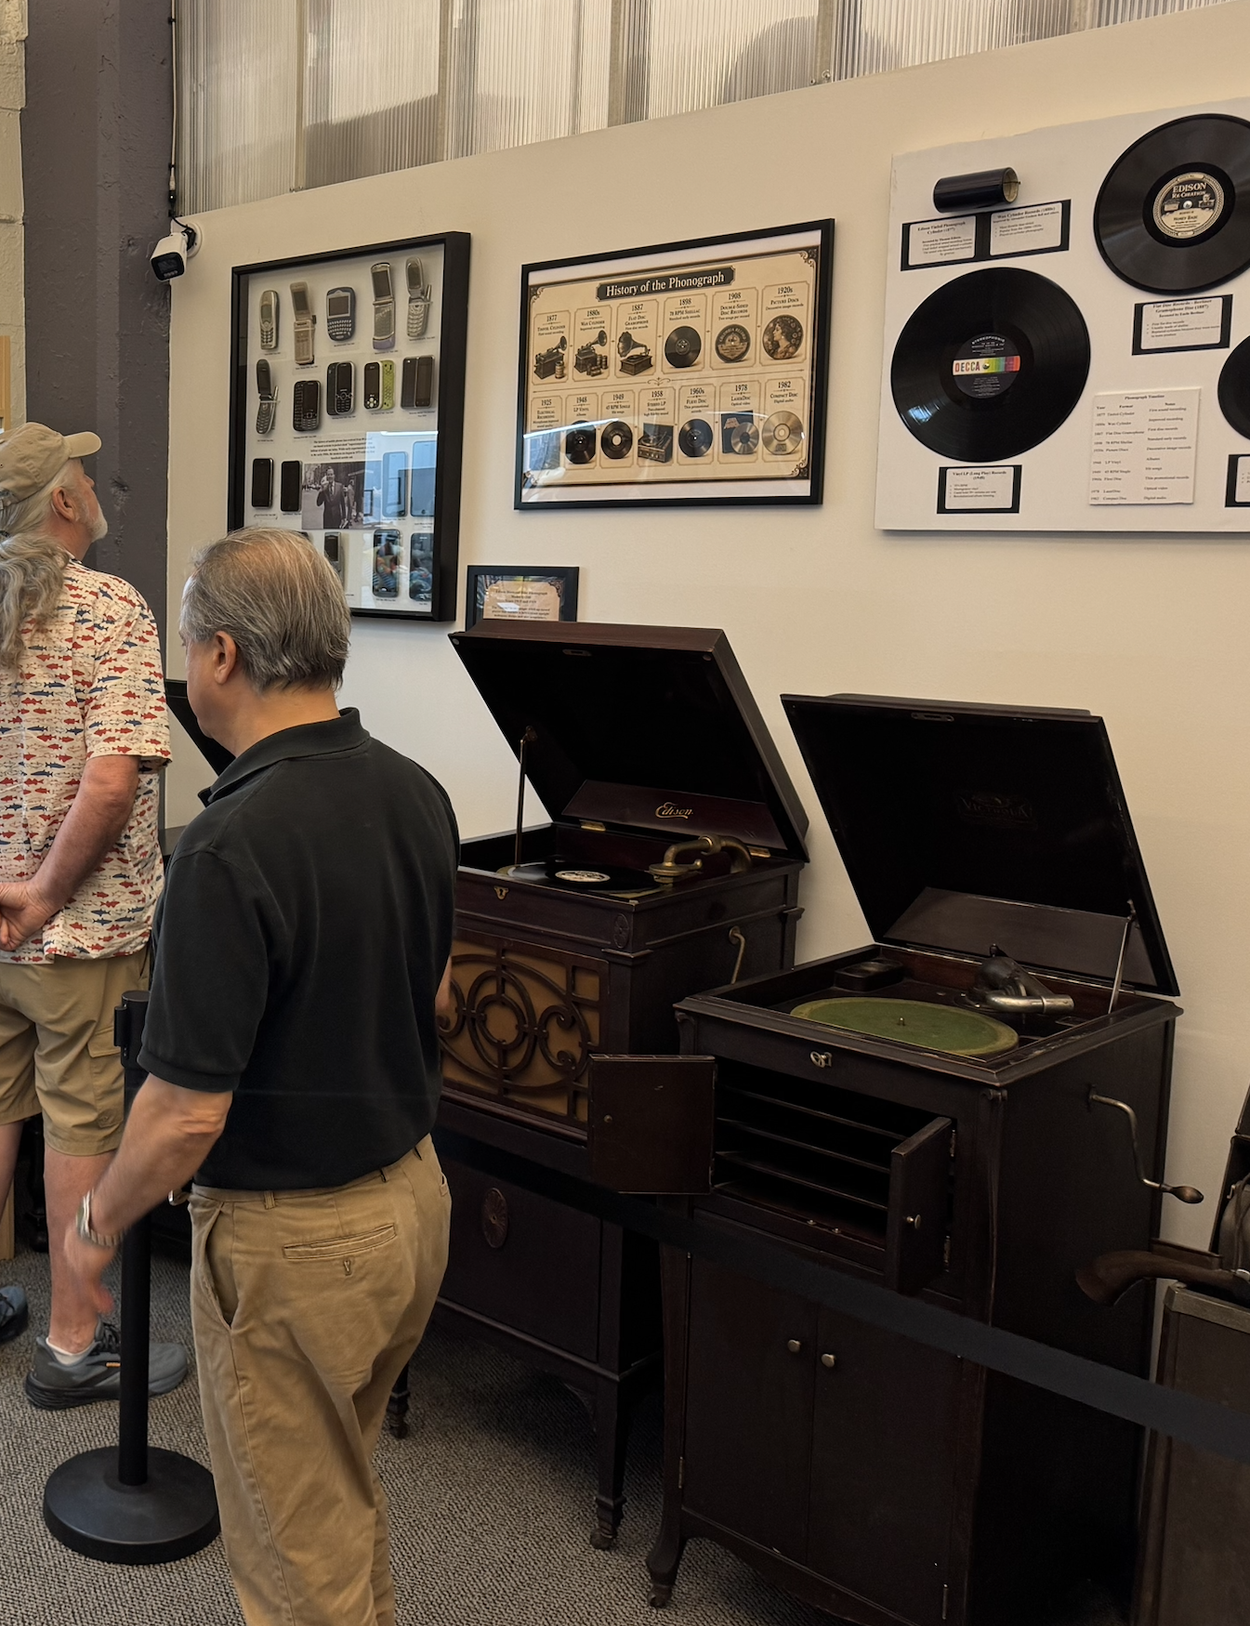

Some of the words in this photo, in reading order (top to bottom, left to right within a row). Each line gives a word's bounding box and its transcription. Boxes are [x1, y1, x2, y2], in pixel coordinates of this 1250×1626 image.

[1172, 182, 1206, 192] EDISON
[606, 284, 638, 296] History
[640, 280, 650, 292] of
[652, 280, 666, 290] the
[669, 272, 724, 288] Phonograph
[954, 362, 980, 372] DECCA
[655, 802, 693, 819] Edison
